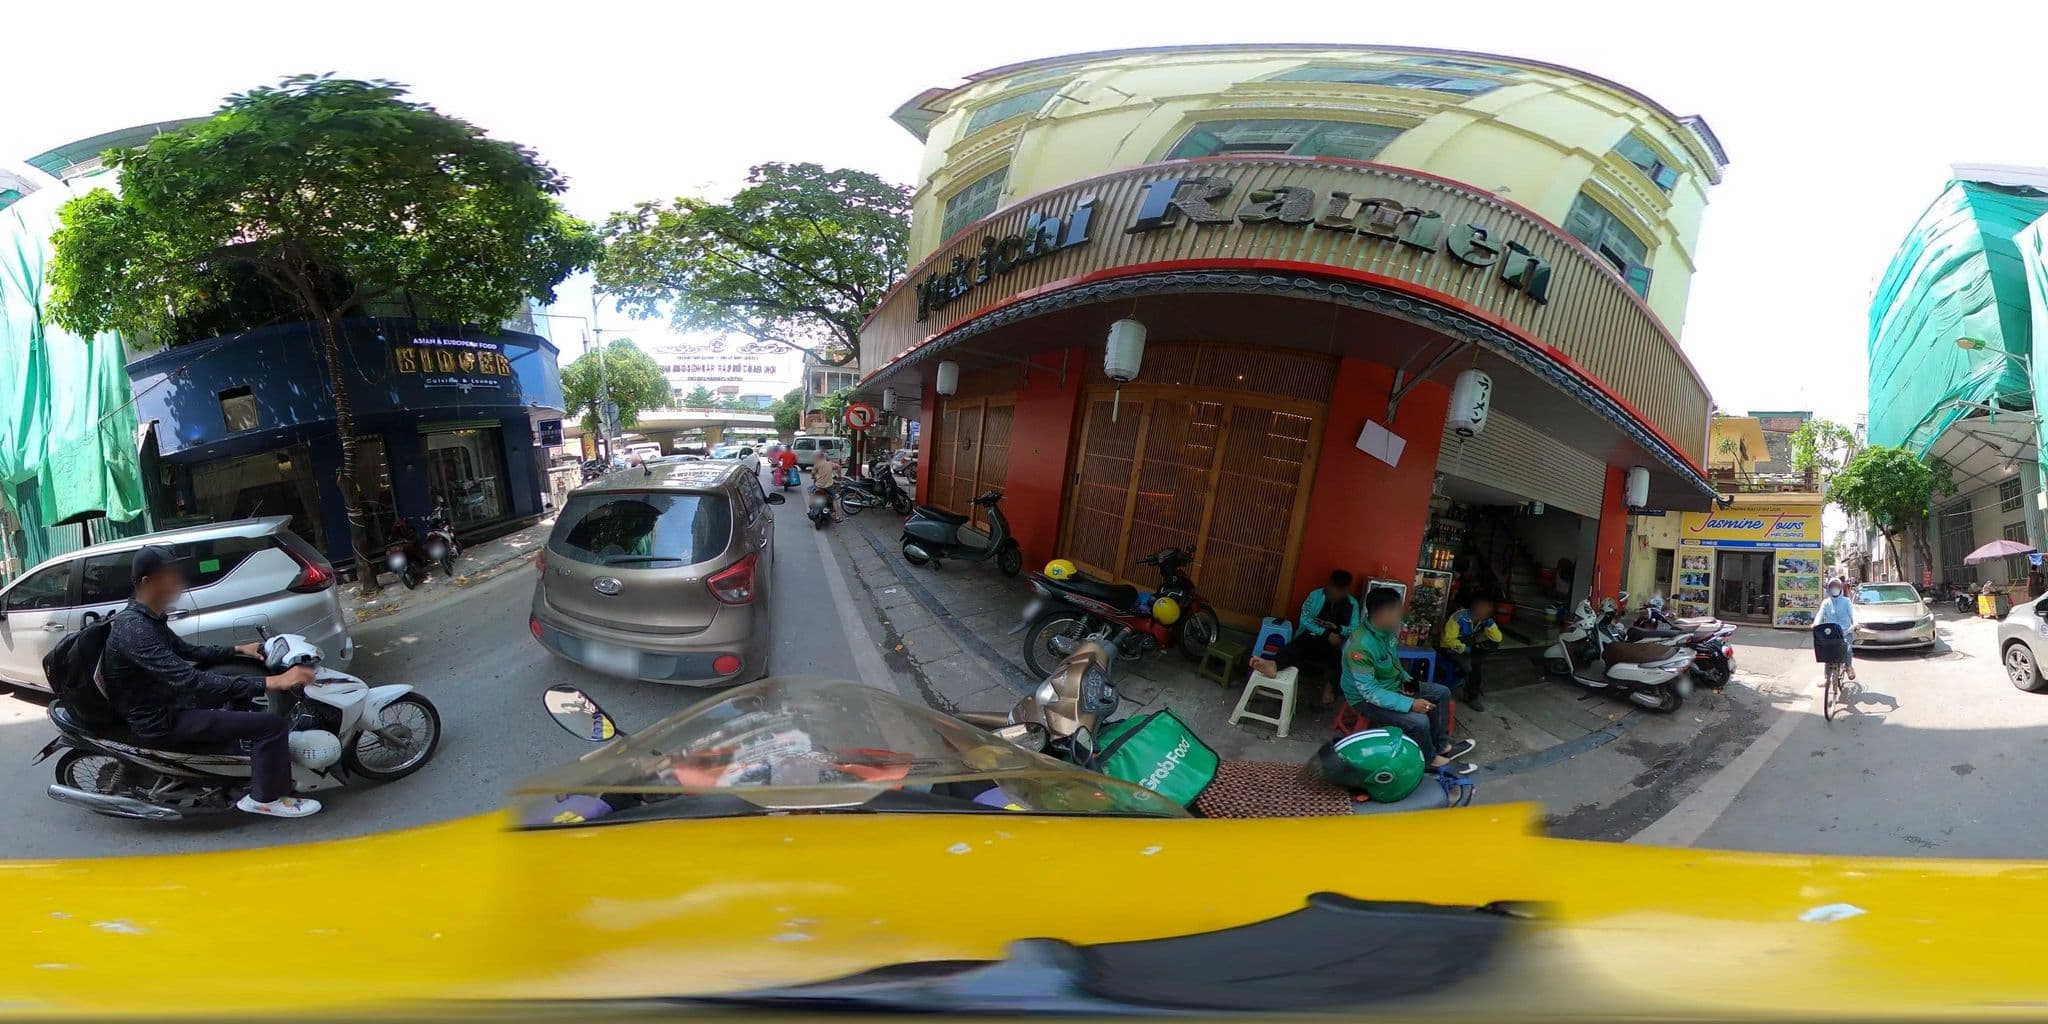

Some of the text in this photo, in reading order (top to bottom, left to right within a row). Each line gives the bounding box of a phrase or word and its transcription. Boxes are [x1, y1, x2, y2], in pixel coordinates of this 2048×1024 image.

[1126, 175, 1551, 305] Ramen
[443, 339, 478, 348] EUROPEAN
[479, 342, 498, 350] FOOD
[1470, 376, 1489, 424] ラーメン
[1689, 511, 1812, 538] Jasmine Tours
[1134, 736, 1190, 800] GrabFood
